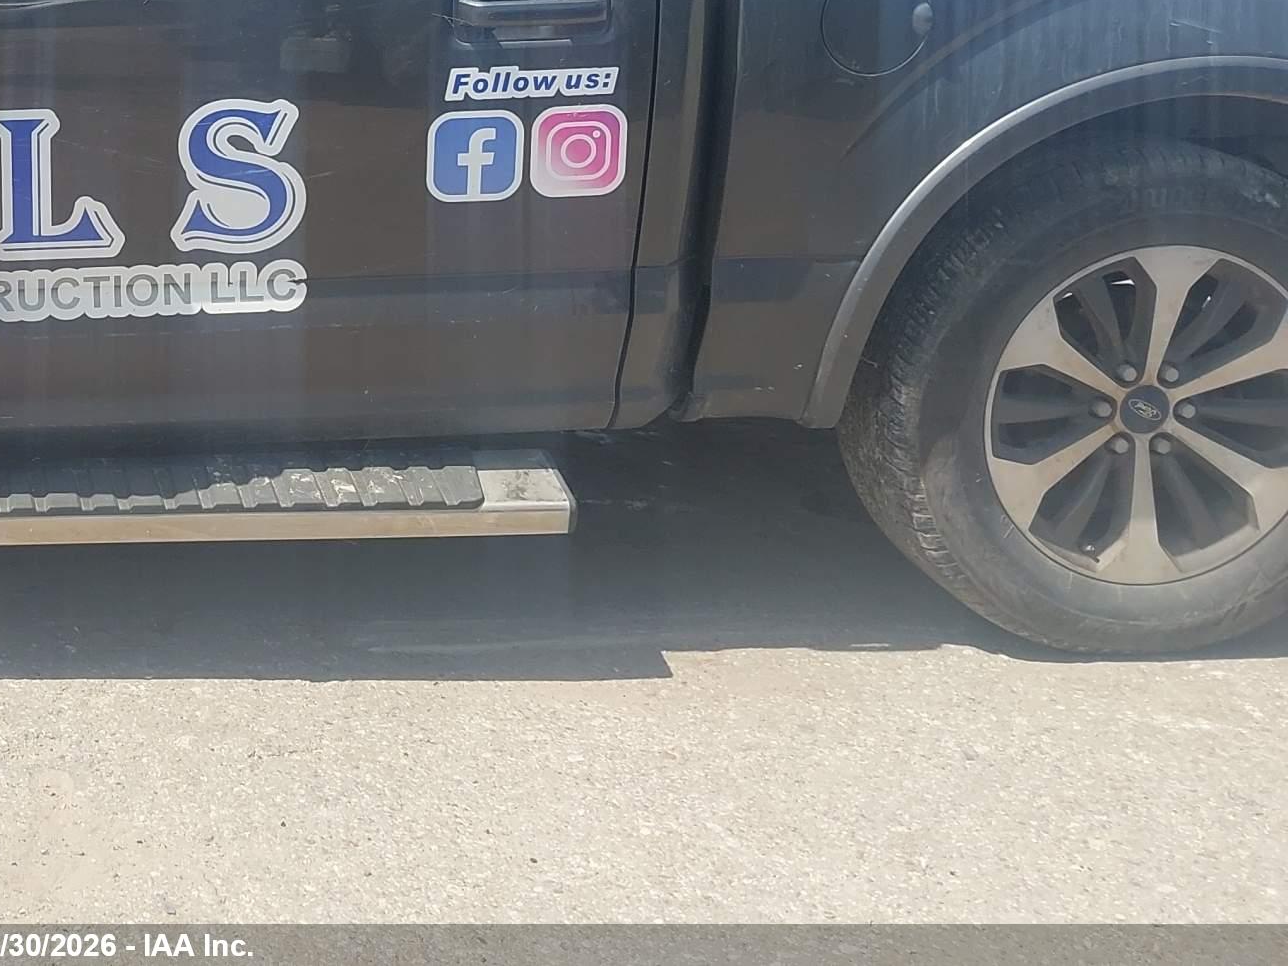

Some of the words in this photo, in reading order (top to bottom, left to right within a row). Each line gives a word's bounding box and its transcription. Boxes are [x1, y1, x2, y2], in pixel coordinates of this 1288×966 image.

[451, 71, 558, 95] Follow
[565, 71, 612, 90] us:
[209, 268, 298, 303] LLC
